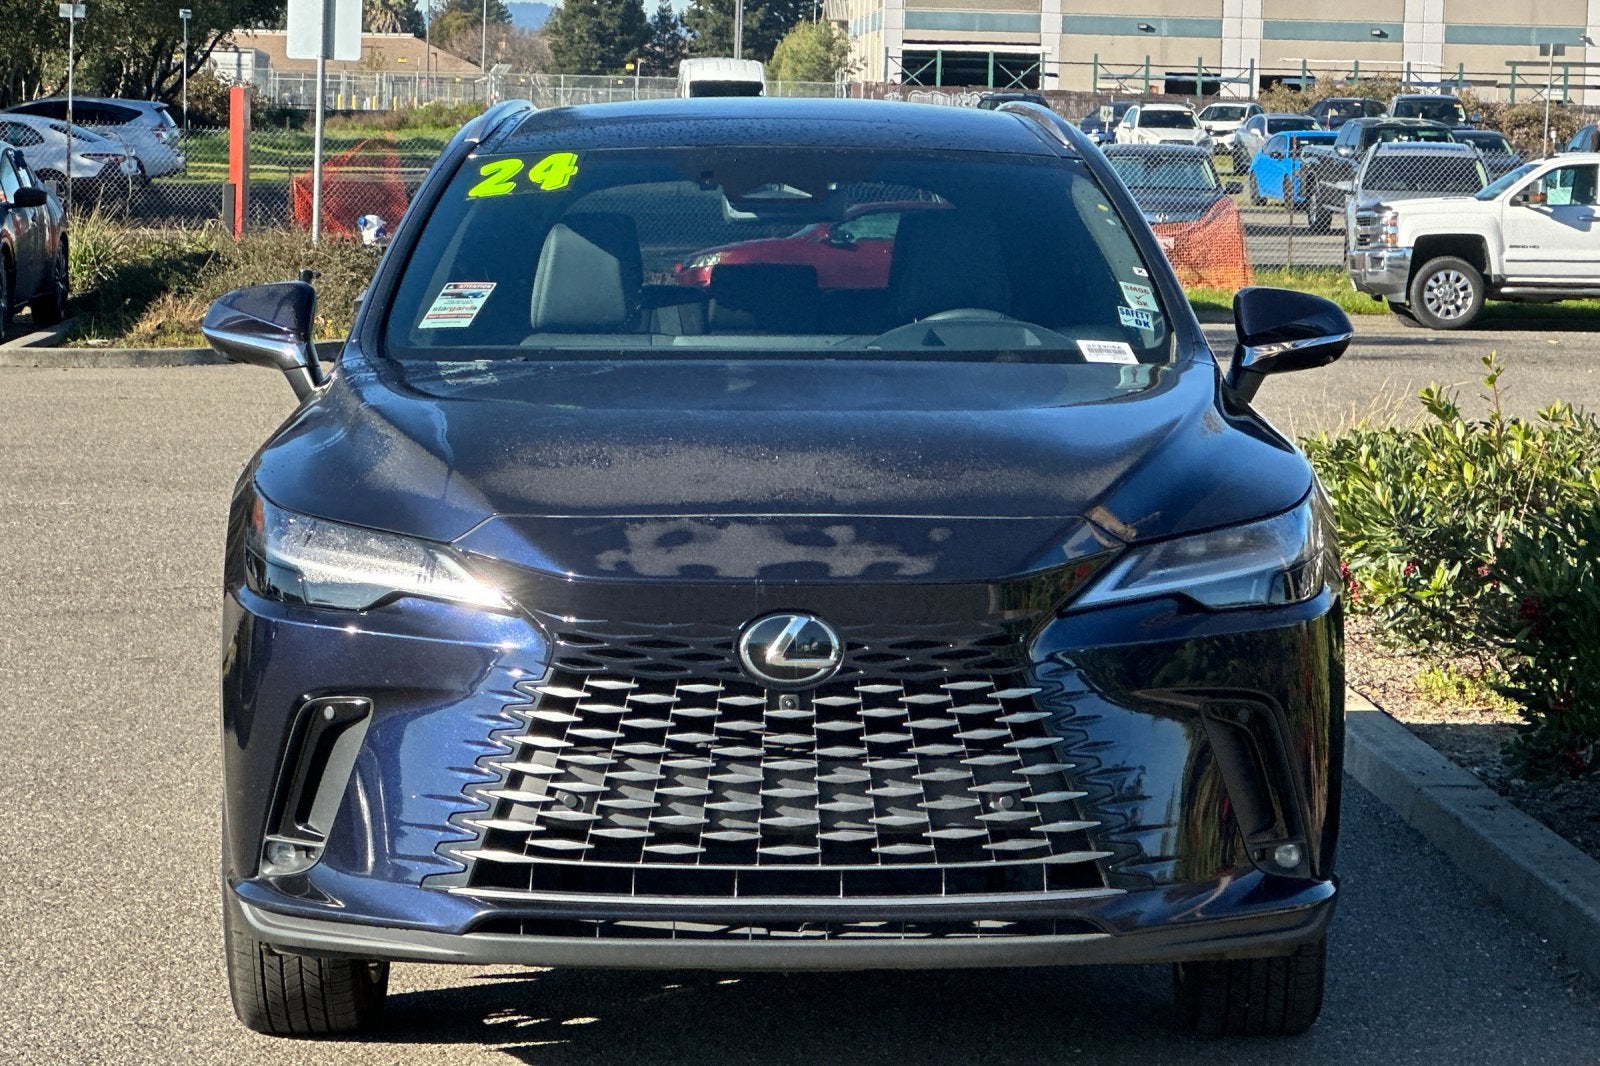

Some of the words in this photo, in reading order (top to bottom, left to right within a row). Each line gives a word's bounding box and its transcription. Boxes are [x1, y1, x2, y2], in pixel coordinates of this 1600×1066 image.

[466, 152, 579, 200] 24
[1123, 285, 1150, 294] SMOG
[1119, 307, 1150, 320] SAFETY
[1135, 318, 1151, 328] OK
